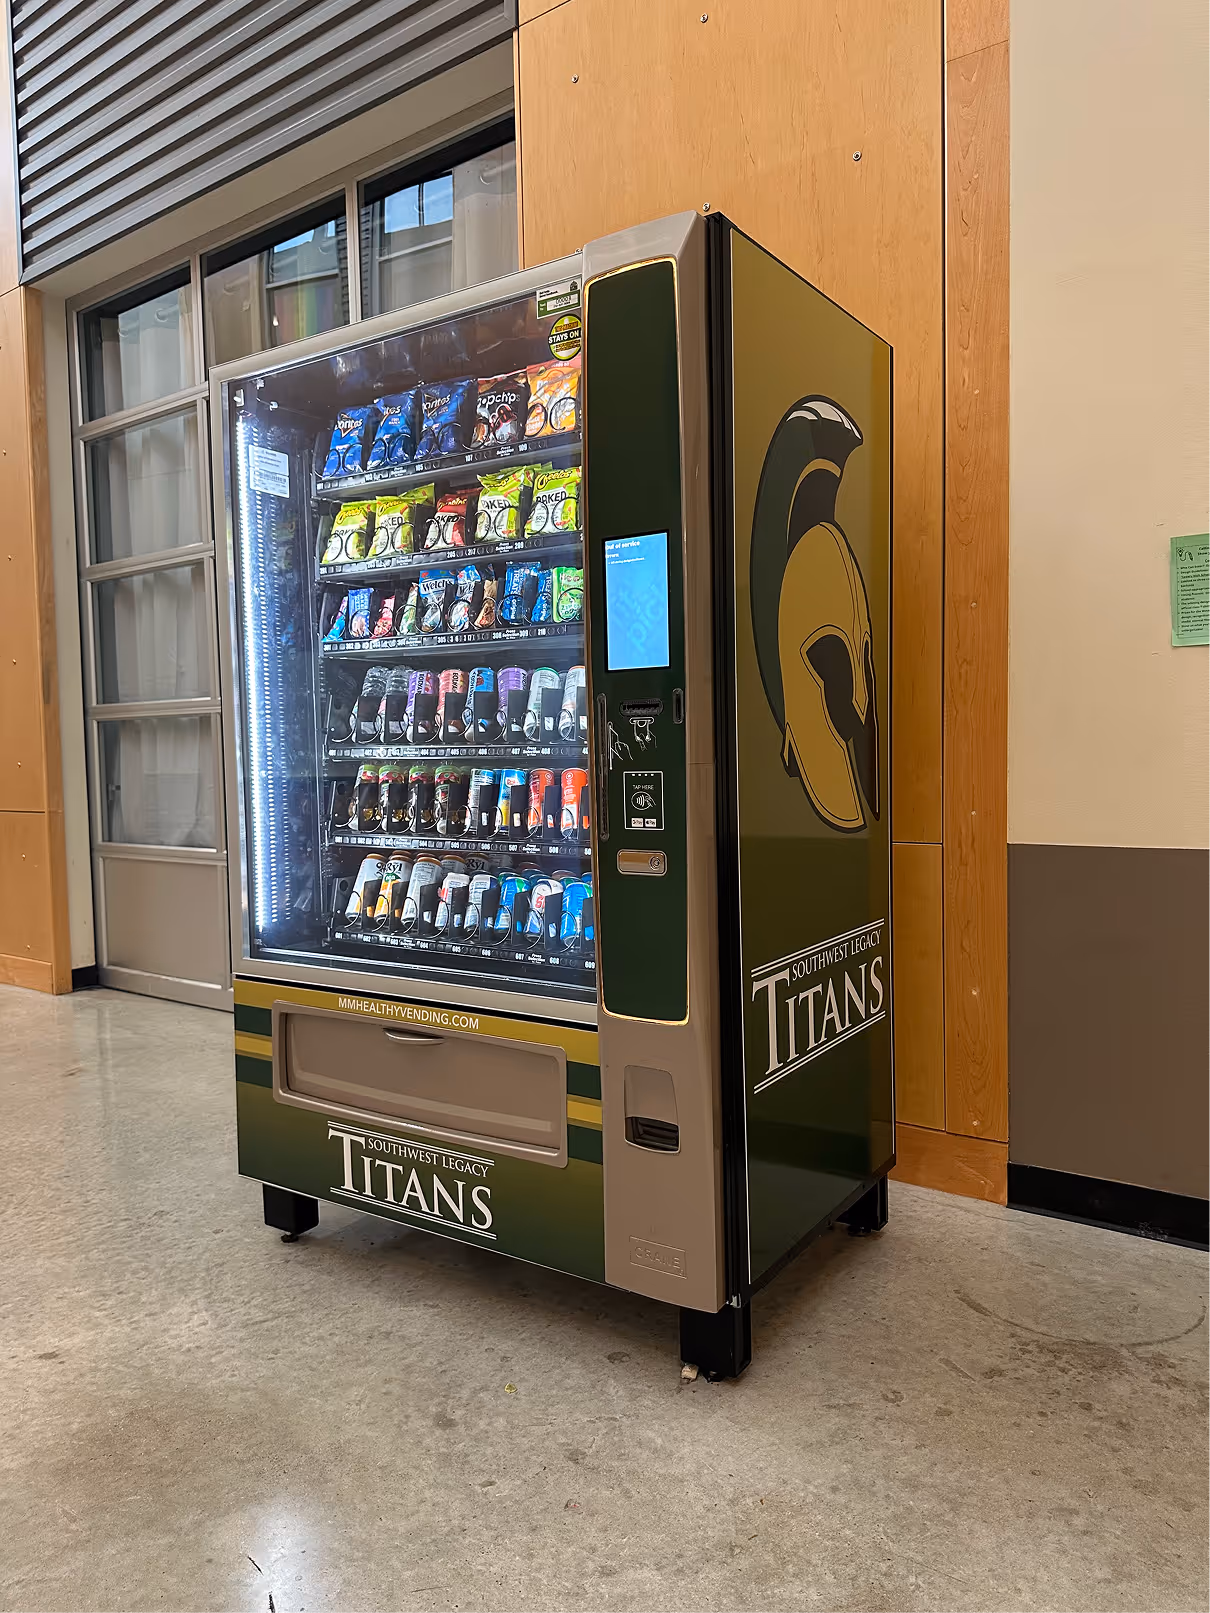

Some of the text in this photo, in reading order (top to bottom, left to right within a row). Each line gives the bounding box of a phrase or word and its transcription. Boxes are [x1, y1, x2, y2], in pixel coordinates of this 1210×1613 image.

[548, 330, 579, 344] STAYS ON
[792, 929, 882, 981] SOUTHWEST LEGACY
[338, 996, 479, 1030] MMHEALTHYVENDING.COM
[752, 956, 884, 1075] TITANS
[328, 1128, 494, 1230] TITANS
[368, 1138, 489, 1178] SOUTHWEST LEGACY
